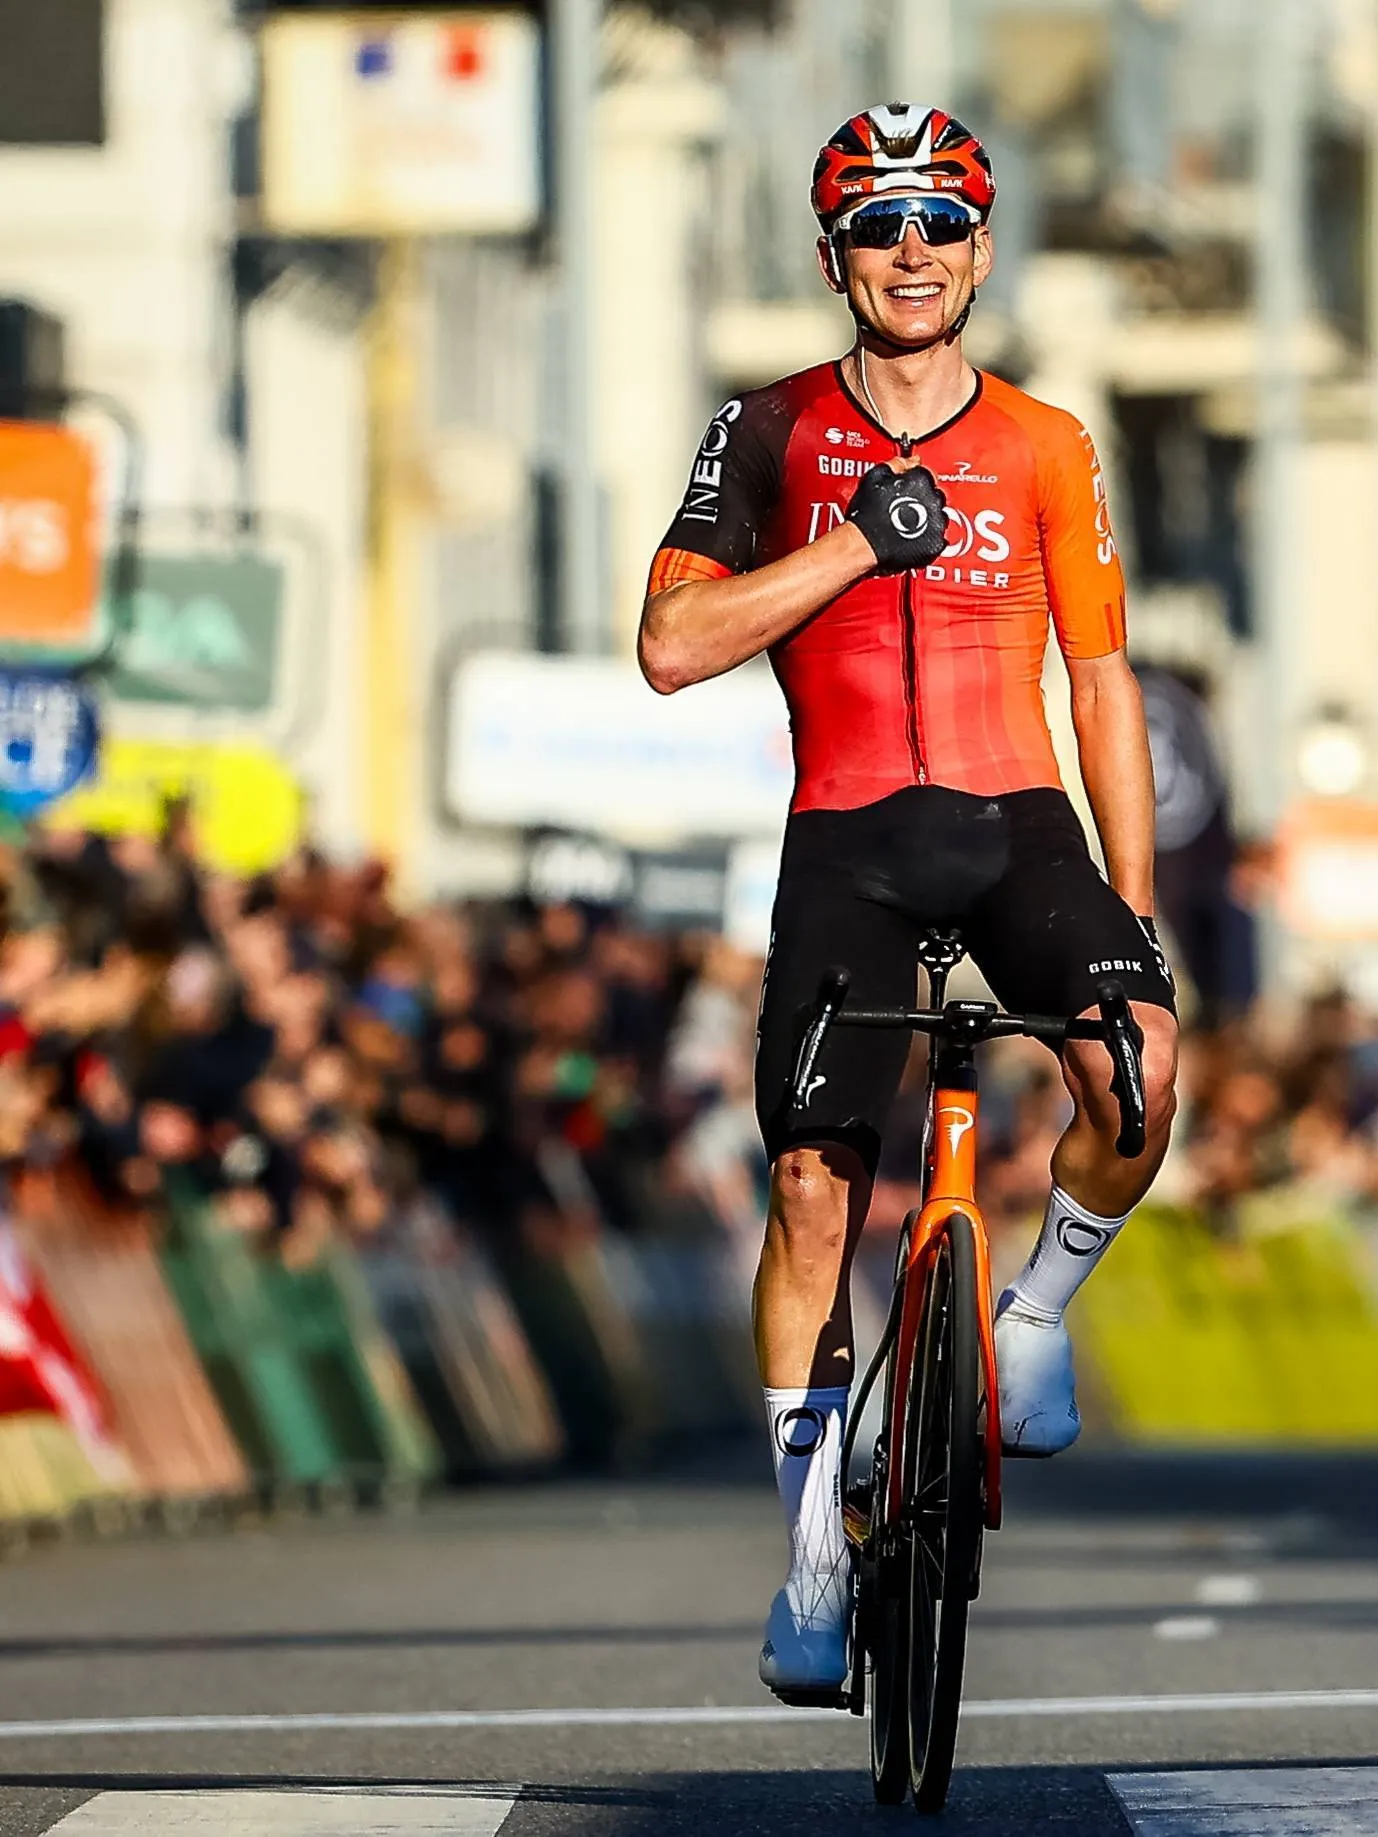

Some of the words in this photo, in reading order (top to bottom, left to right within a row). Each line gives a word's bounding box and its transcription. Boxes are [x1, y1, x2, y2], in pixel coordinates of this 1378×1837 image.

[681, 399, 743, 524] INEOS
[808, 500, 1010, 563] INOS
[1088, 959, 1143, 975] GOBIK
